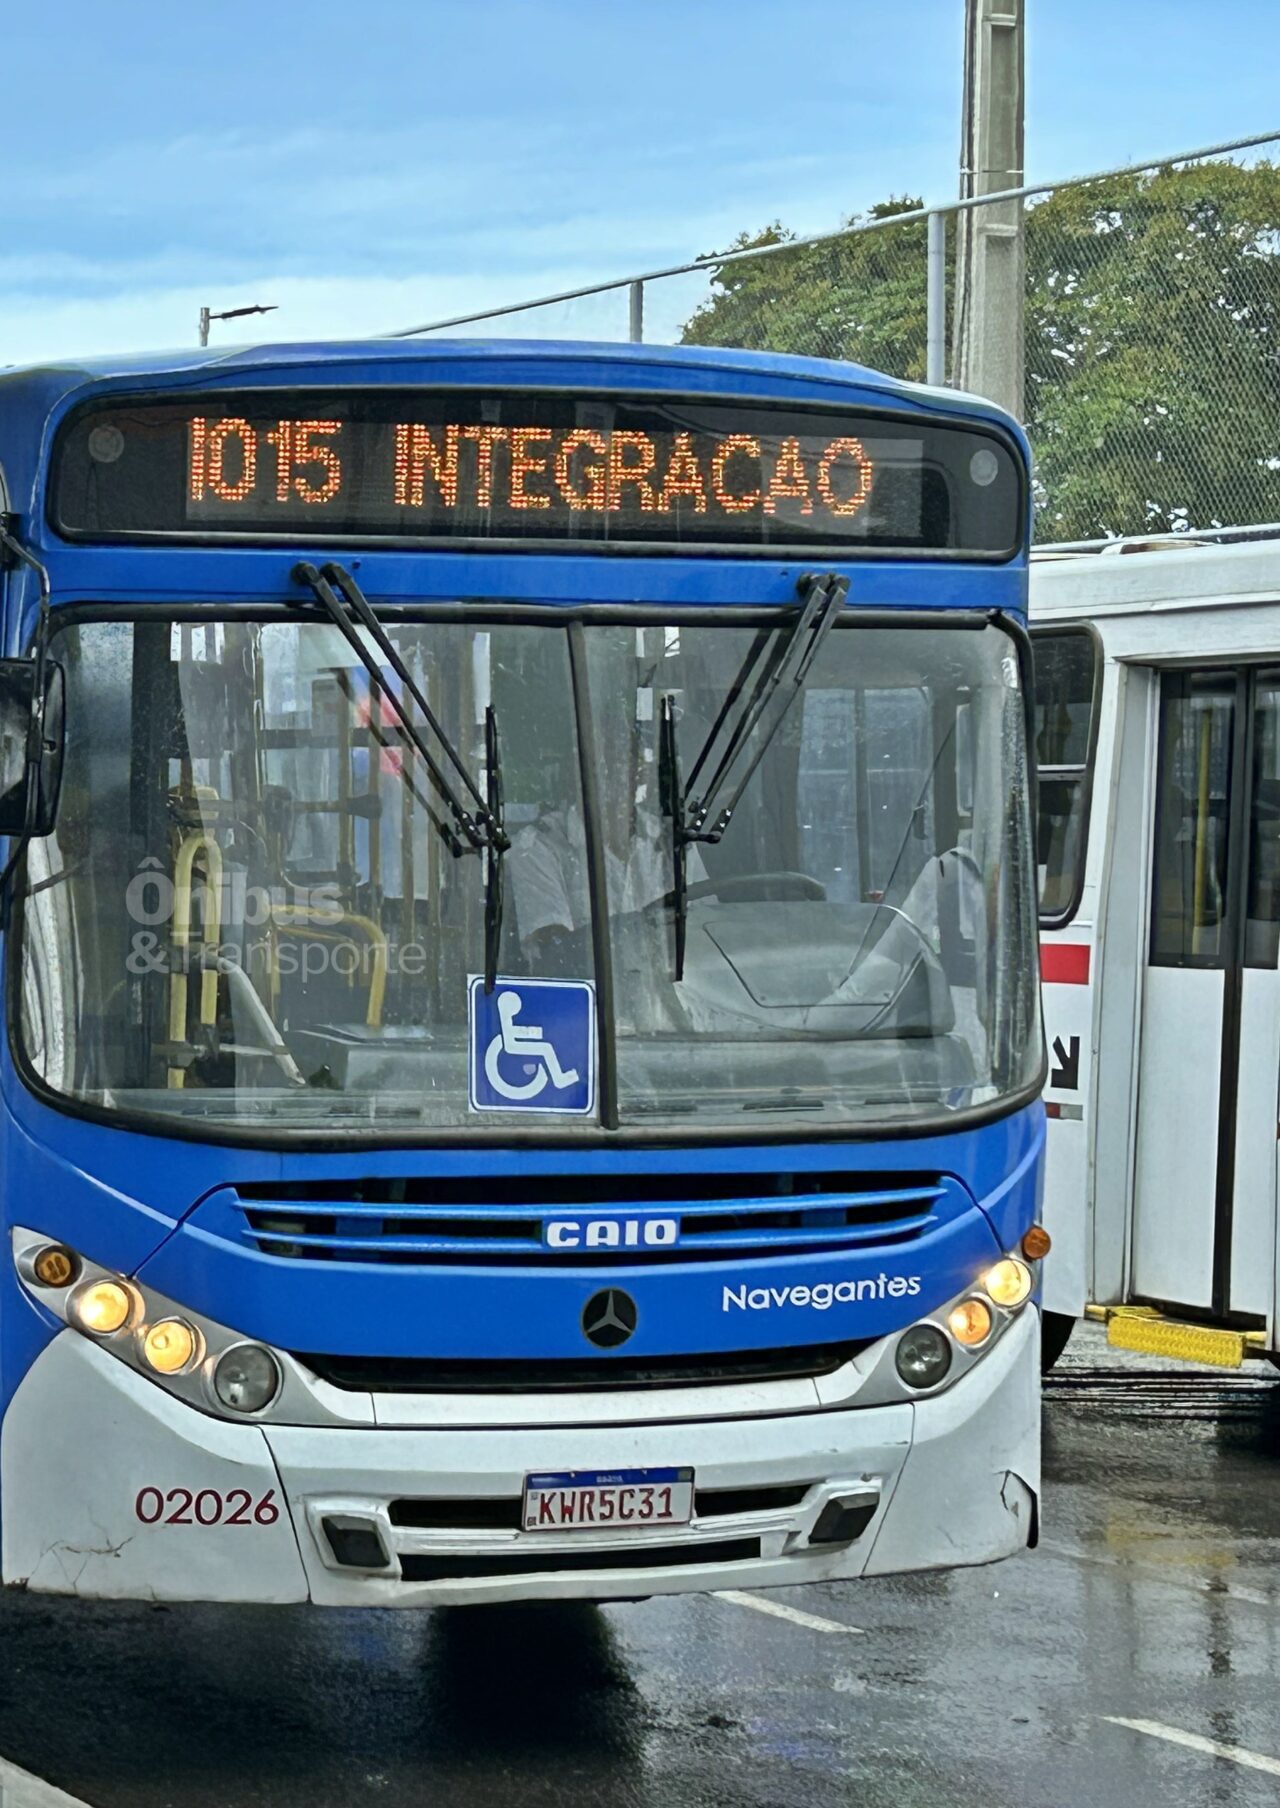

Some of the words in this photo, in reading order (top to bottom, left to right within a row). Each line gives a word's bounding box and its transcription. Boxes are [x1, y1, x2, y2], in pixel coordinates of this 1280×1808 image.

[394, 423, 873, 516] INTEGRACAO
[546, 1219, 677, 1247] CAIO
[722, 1273, 921, 1313] Navegantes
[135, 1486, 280, 1526] 02026
[538, 1486, 673, 1525] KWR5C31
